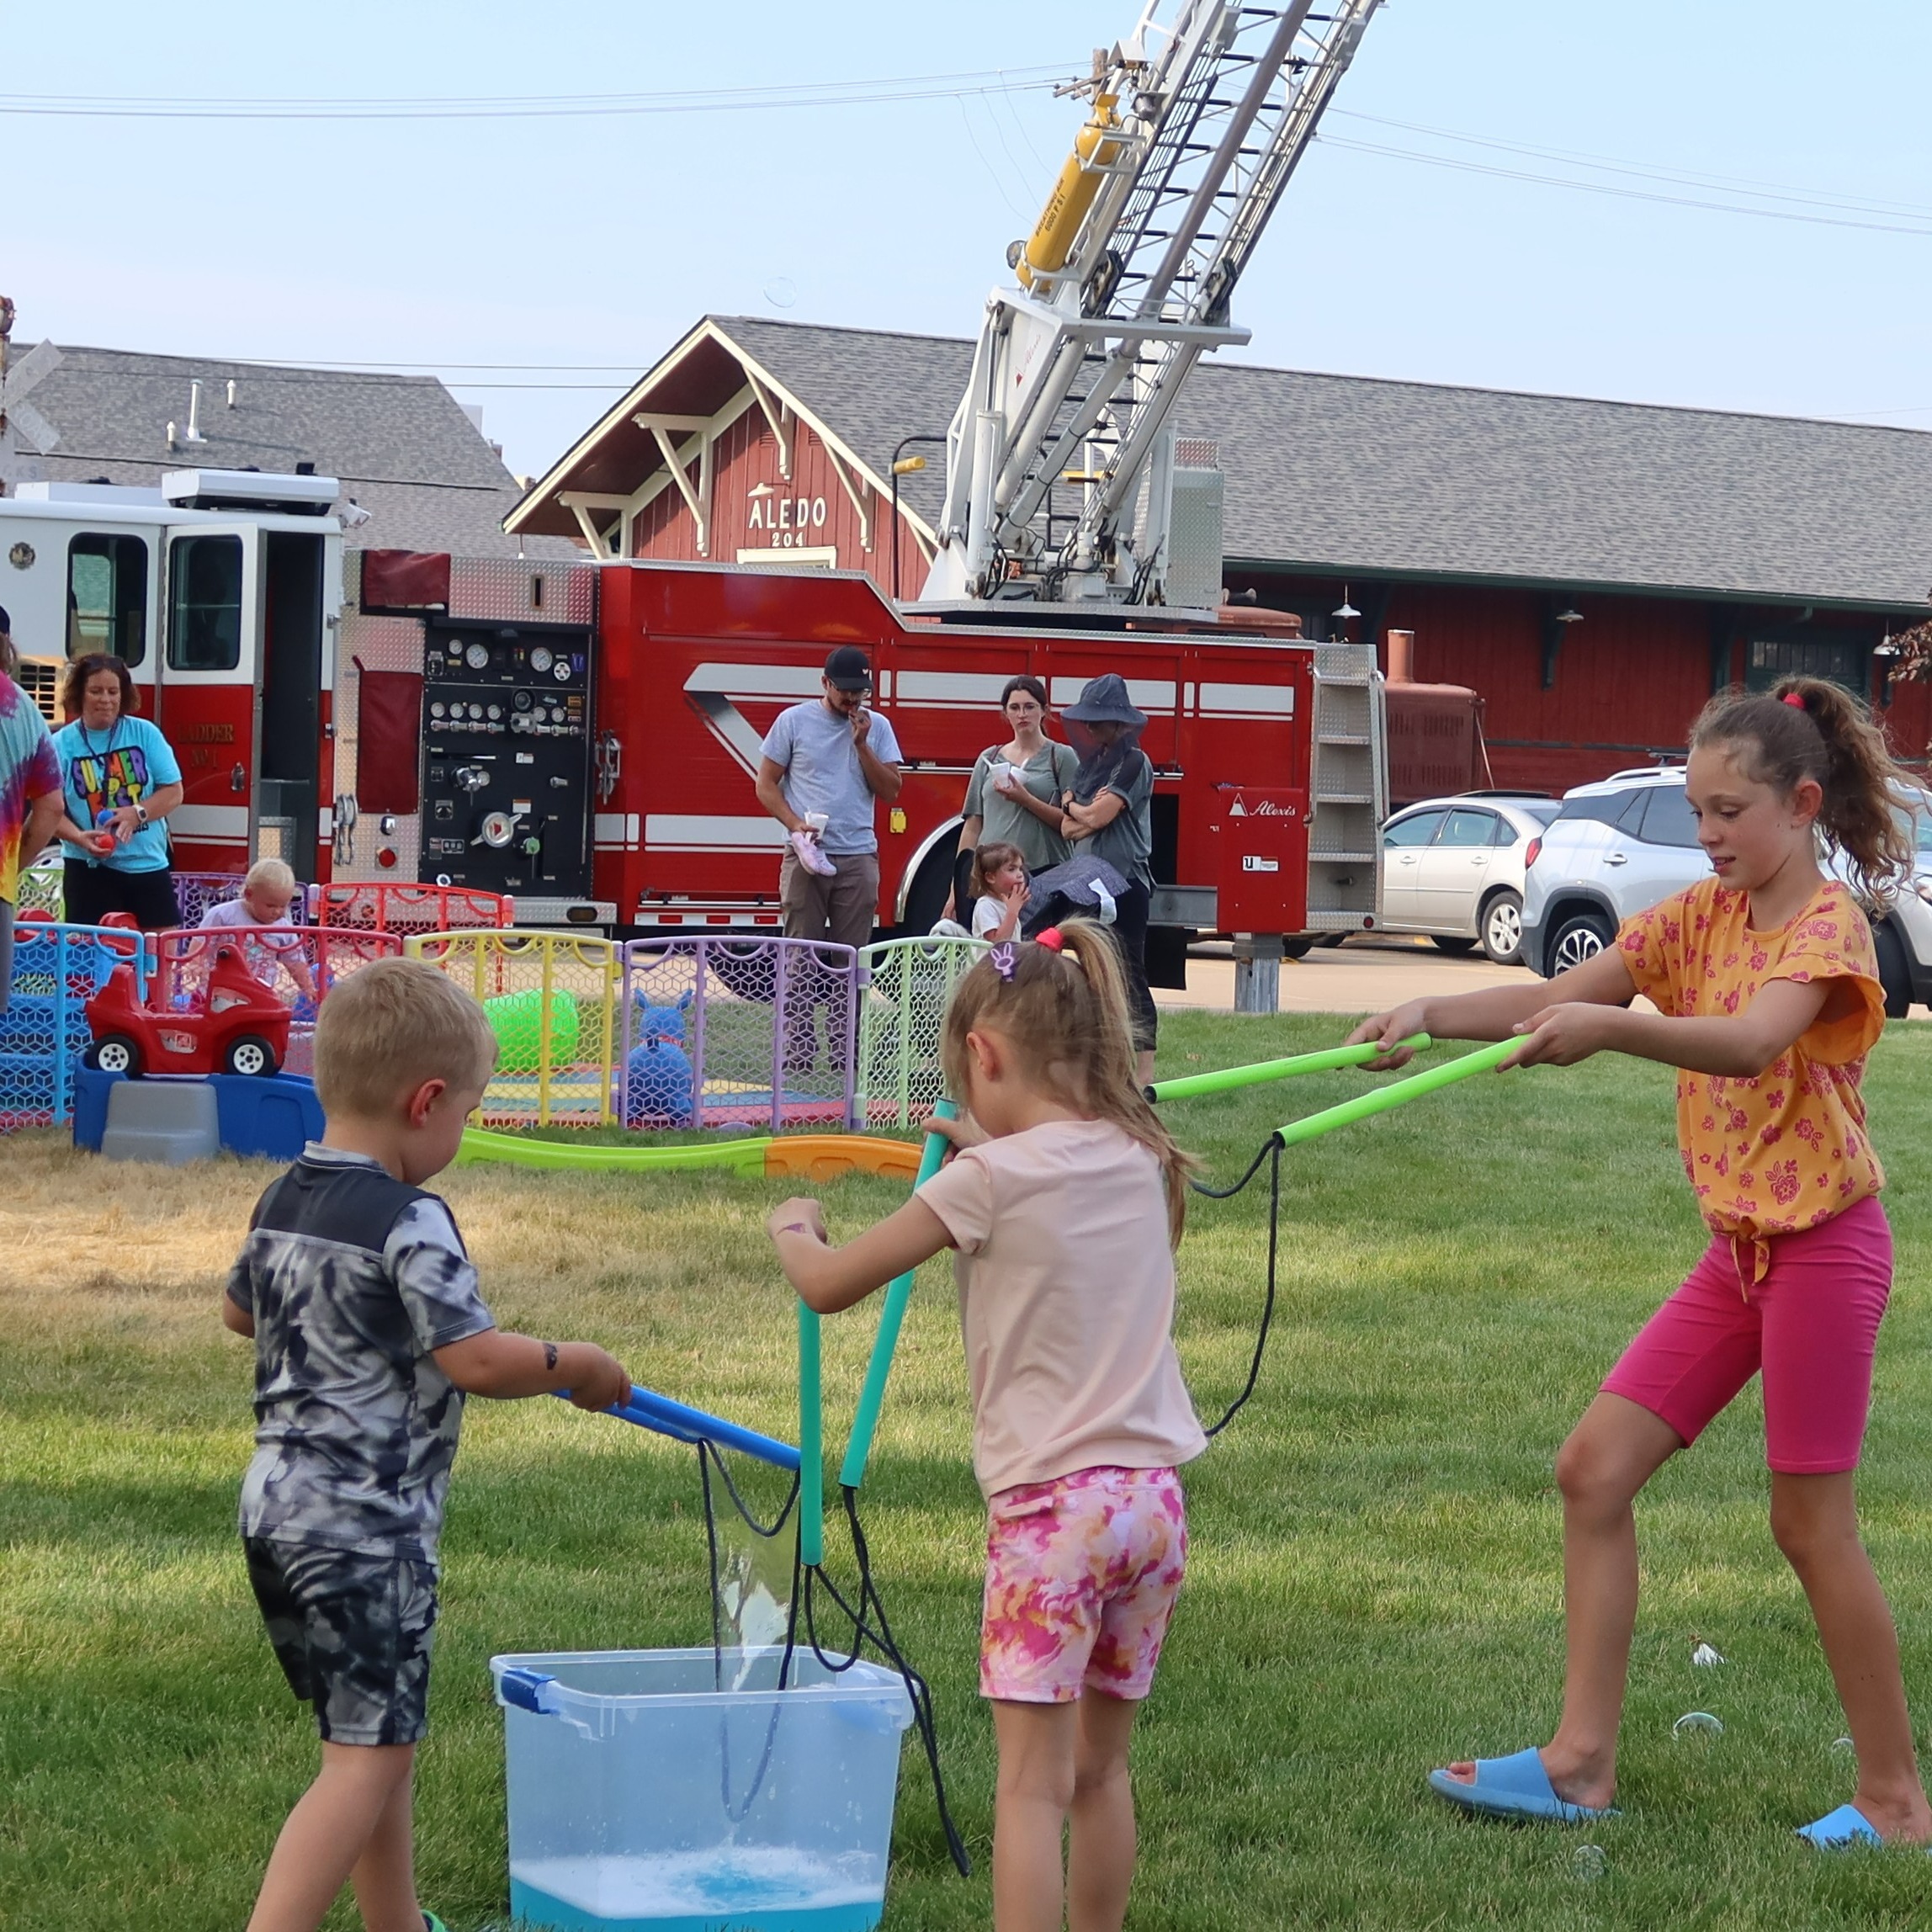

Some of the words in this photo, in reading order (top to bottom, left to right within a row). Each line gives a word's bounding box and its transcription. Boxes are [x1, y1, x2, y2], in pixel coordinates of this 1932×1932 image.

[748, 496, 826, 529] ALEDO
[771, 532, 804, 547] 204
[1249, 800, 1296, 816] Alexis
